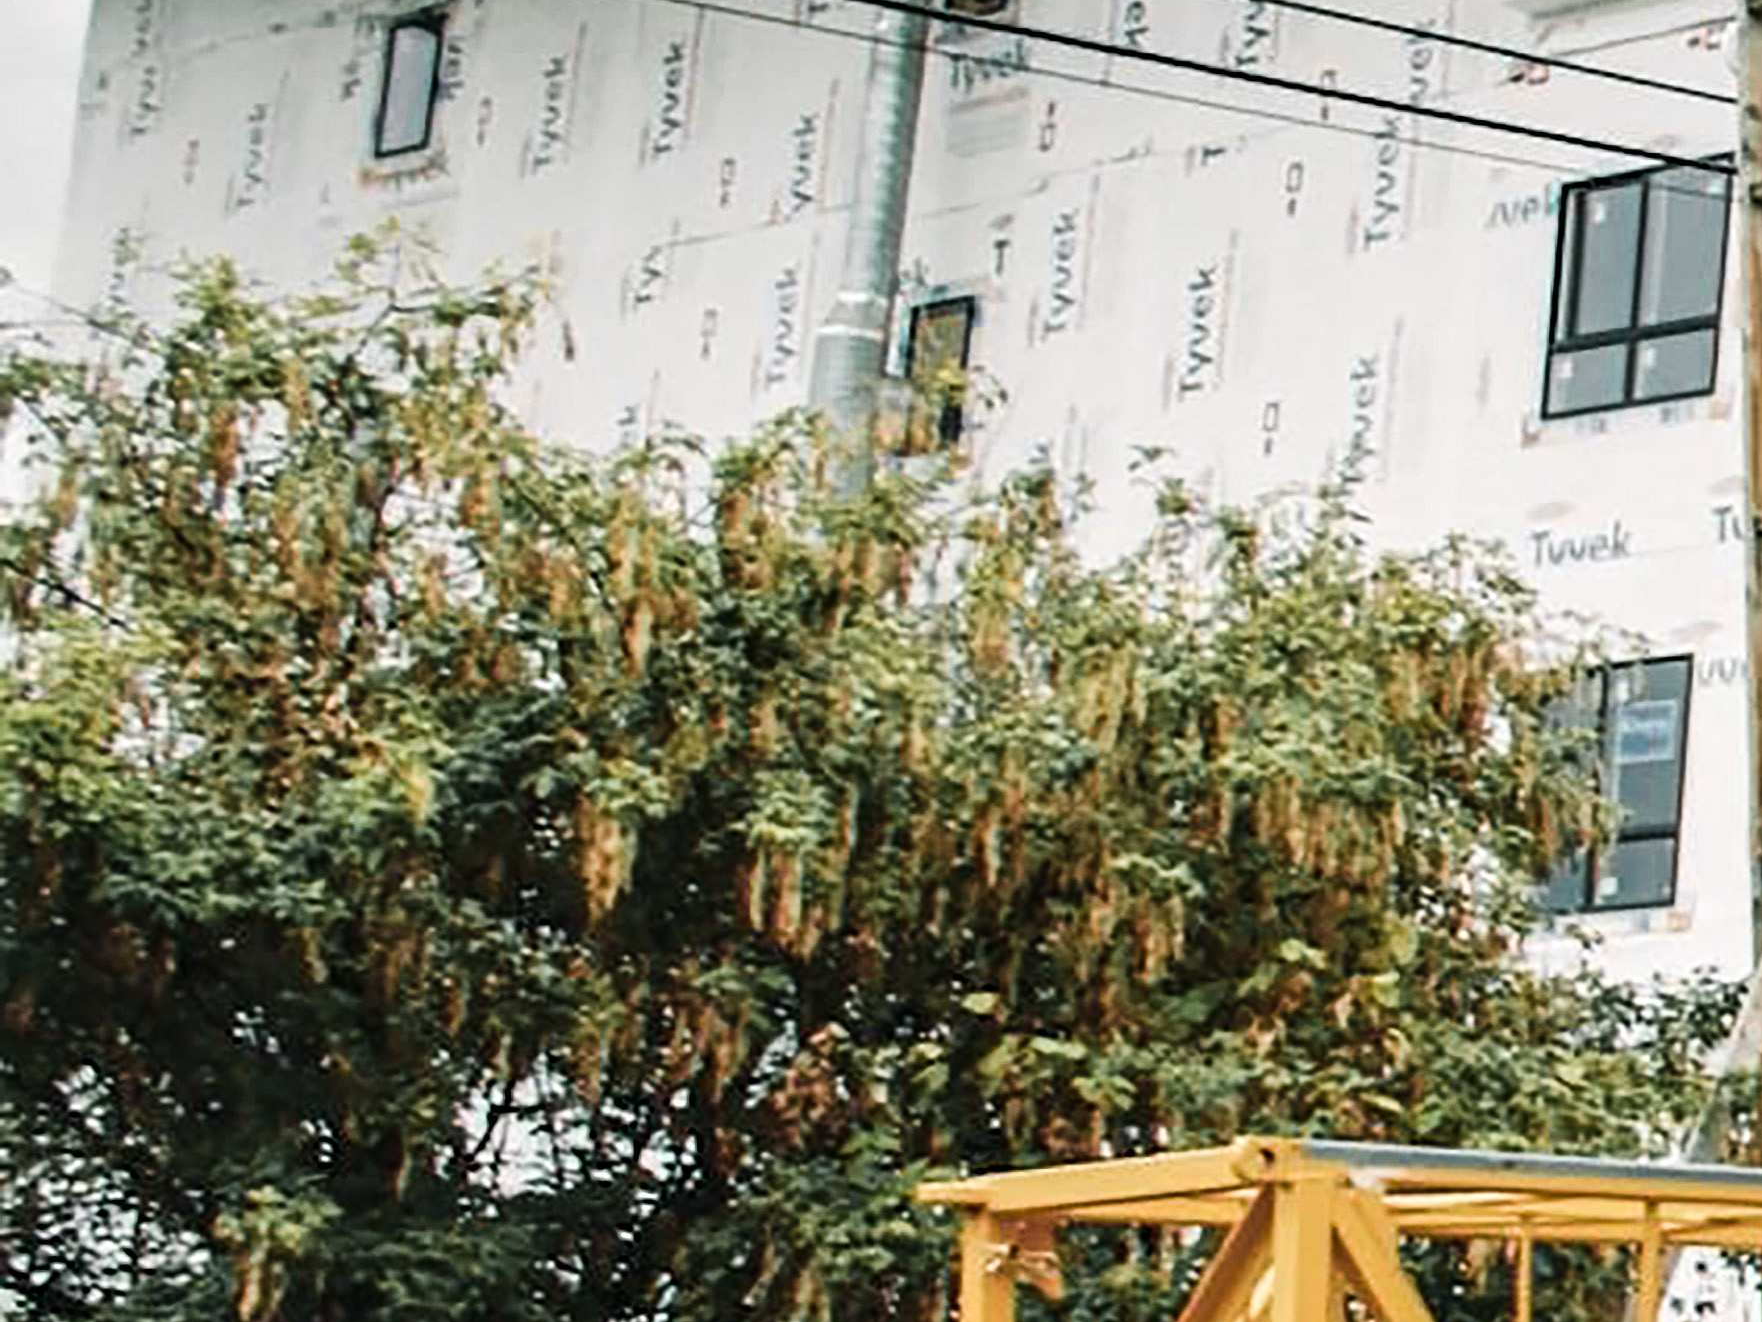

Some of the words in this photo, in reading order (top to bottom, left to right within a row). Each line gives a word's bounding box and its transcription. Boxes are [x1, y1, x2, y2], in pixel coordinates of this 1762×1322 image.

[652, 41, 686, 159] Tyvek
[786, 113, 819, 222] yvek
[1364, 113, 1401, 252] Tyvek
[765, 266, 799, 389] Tyvek
[1043, 208, 1079, 342] Tyvek
[1179, 263, 1217, 401] Tyvek
